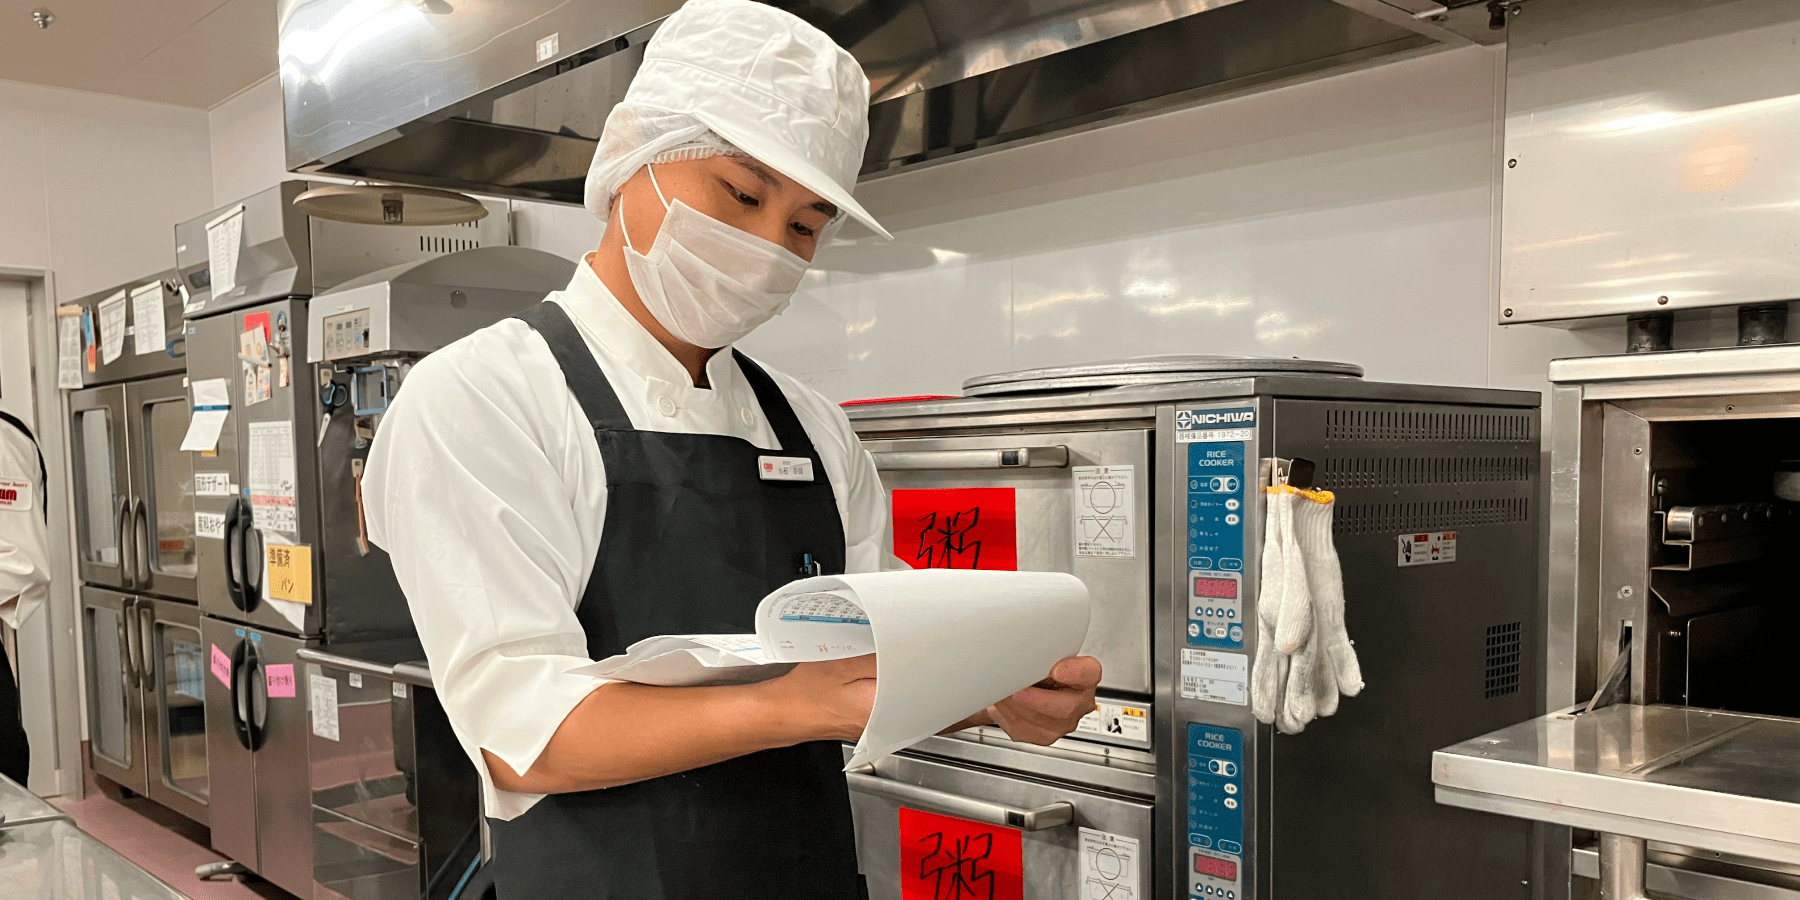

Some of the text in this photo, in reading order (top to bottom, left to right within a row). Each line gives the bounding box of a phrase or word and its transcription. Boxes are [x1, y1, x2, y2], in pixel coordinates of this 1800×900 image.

[1191, 412, 1254, 424] NICHIWA
[1217, 429, 1250, 438] 1972-20
[1206, 450, 1227, 458] RICE
[1198, 458, 1235, 467] COOKER
[197, 515, 226, 534] 産科おや
[916, 507, 982, 569] 粥
[1204, 731, 1225, 742] RICE
[1197, 739, 1233, 752] COOKER
[919, 831, 996, 900] 粥
